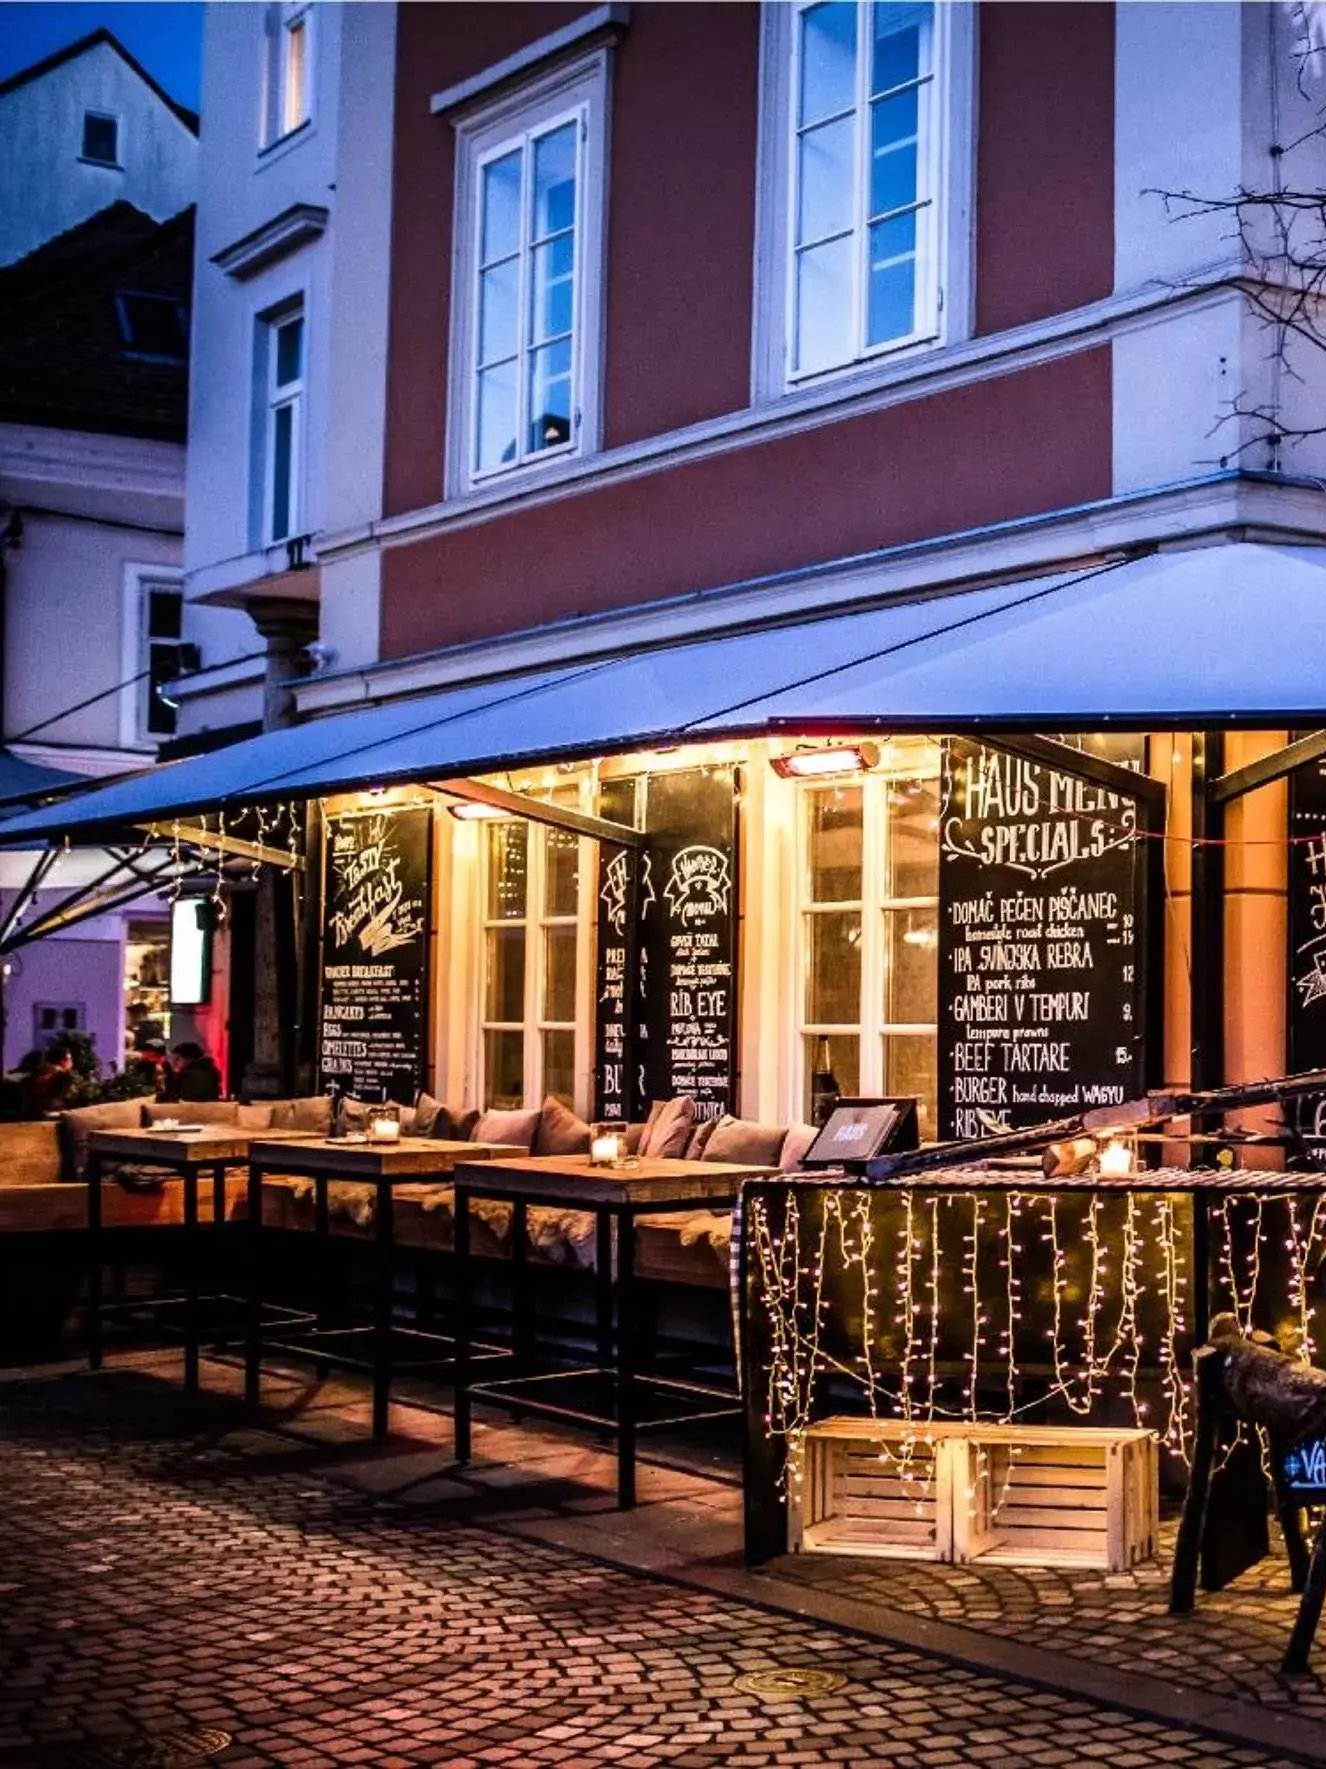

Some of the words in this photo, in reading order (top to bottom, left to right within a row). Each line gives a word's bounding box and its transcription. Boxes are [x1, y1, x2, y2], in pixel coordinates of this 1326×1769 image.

[965, 752, 1041, 819] HAUS
[953, 891, 994, 924] DOMAČ
[1000, 891, 1045, 921] PEČEN
[1050, 886, 1118, 921] PIŠČANEC
[1045, 922, 1085, 939] chicken
[954, 946, 972, 972] IPA
[978, 942, 1042, 971] SVINJSKA
[1047, 942, 1094, 969] REBRA
[984, 974, 1013, 995] pork
[1122, 965, 1135, 983] 12
[671, 988, 693, 1016] RIB
[698, 990, 727, 1016] EYE
[954, 993, 1008, 1021] GAMBERI
[1015, 994, 1027, 1021] V
[1029, 991, 1090, 1021] TEMPURI
[955, 1043, 995, 1071] BEEF
[1001, 1043, 1071, 1072] TARTARE
[955, 1077, 1008, 1104] BURGER
[1038, 1084, 1080, 1107] chopped
[1082, 1085, 1124, 1105] WAGYU
[956, 1107, 979, 1138] RIB
